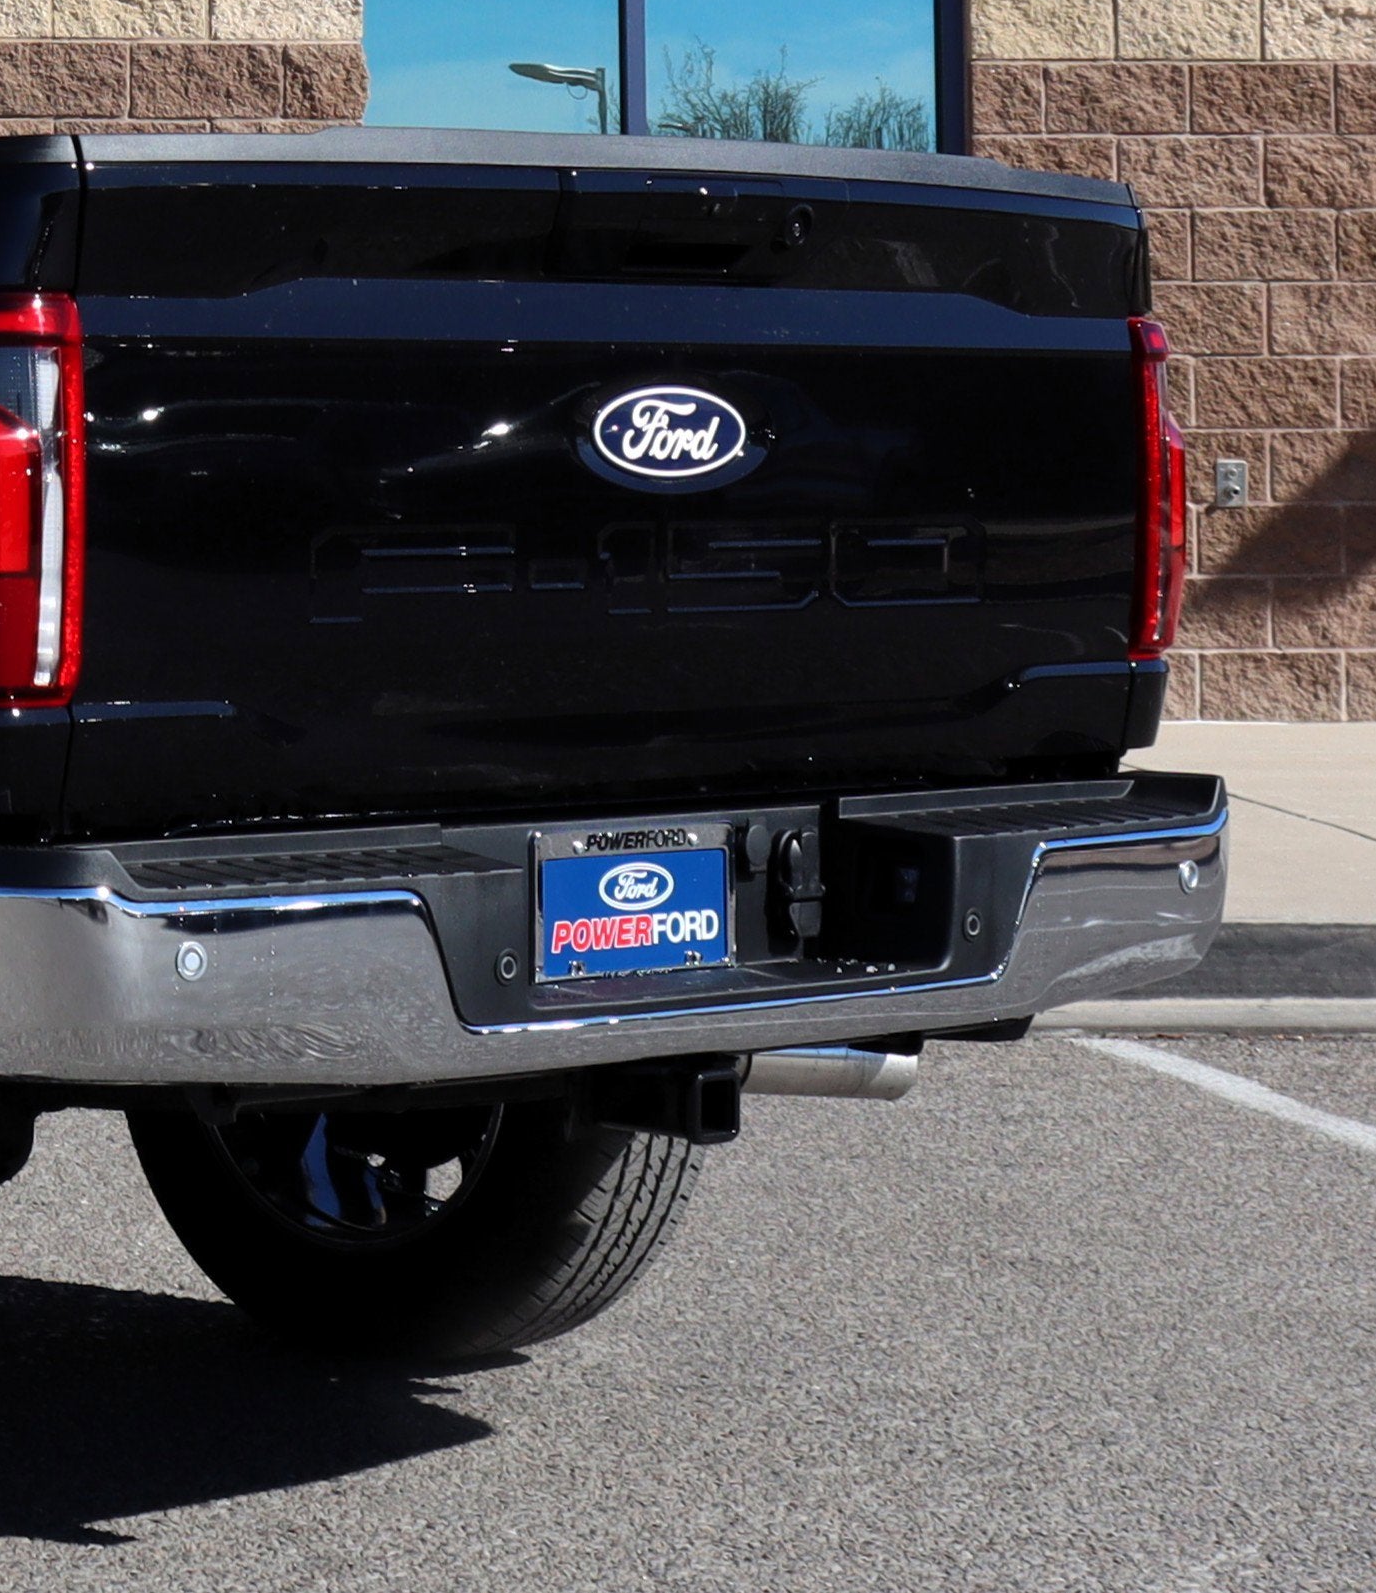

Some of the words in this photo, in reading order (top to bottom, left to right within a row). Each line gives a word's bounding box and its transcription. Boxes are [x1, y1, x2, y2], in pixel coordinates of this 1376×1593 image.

[622, 399, 719, 461] Ford
[613, 871, 658, 900] Ford
[551, 909, 719, 953] POWERFORD
